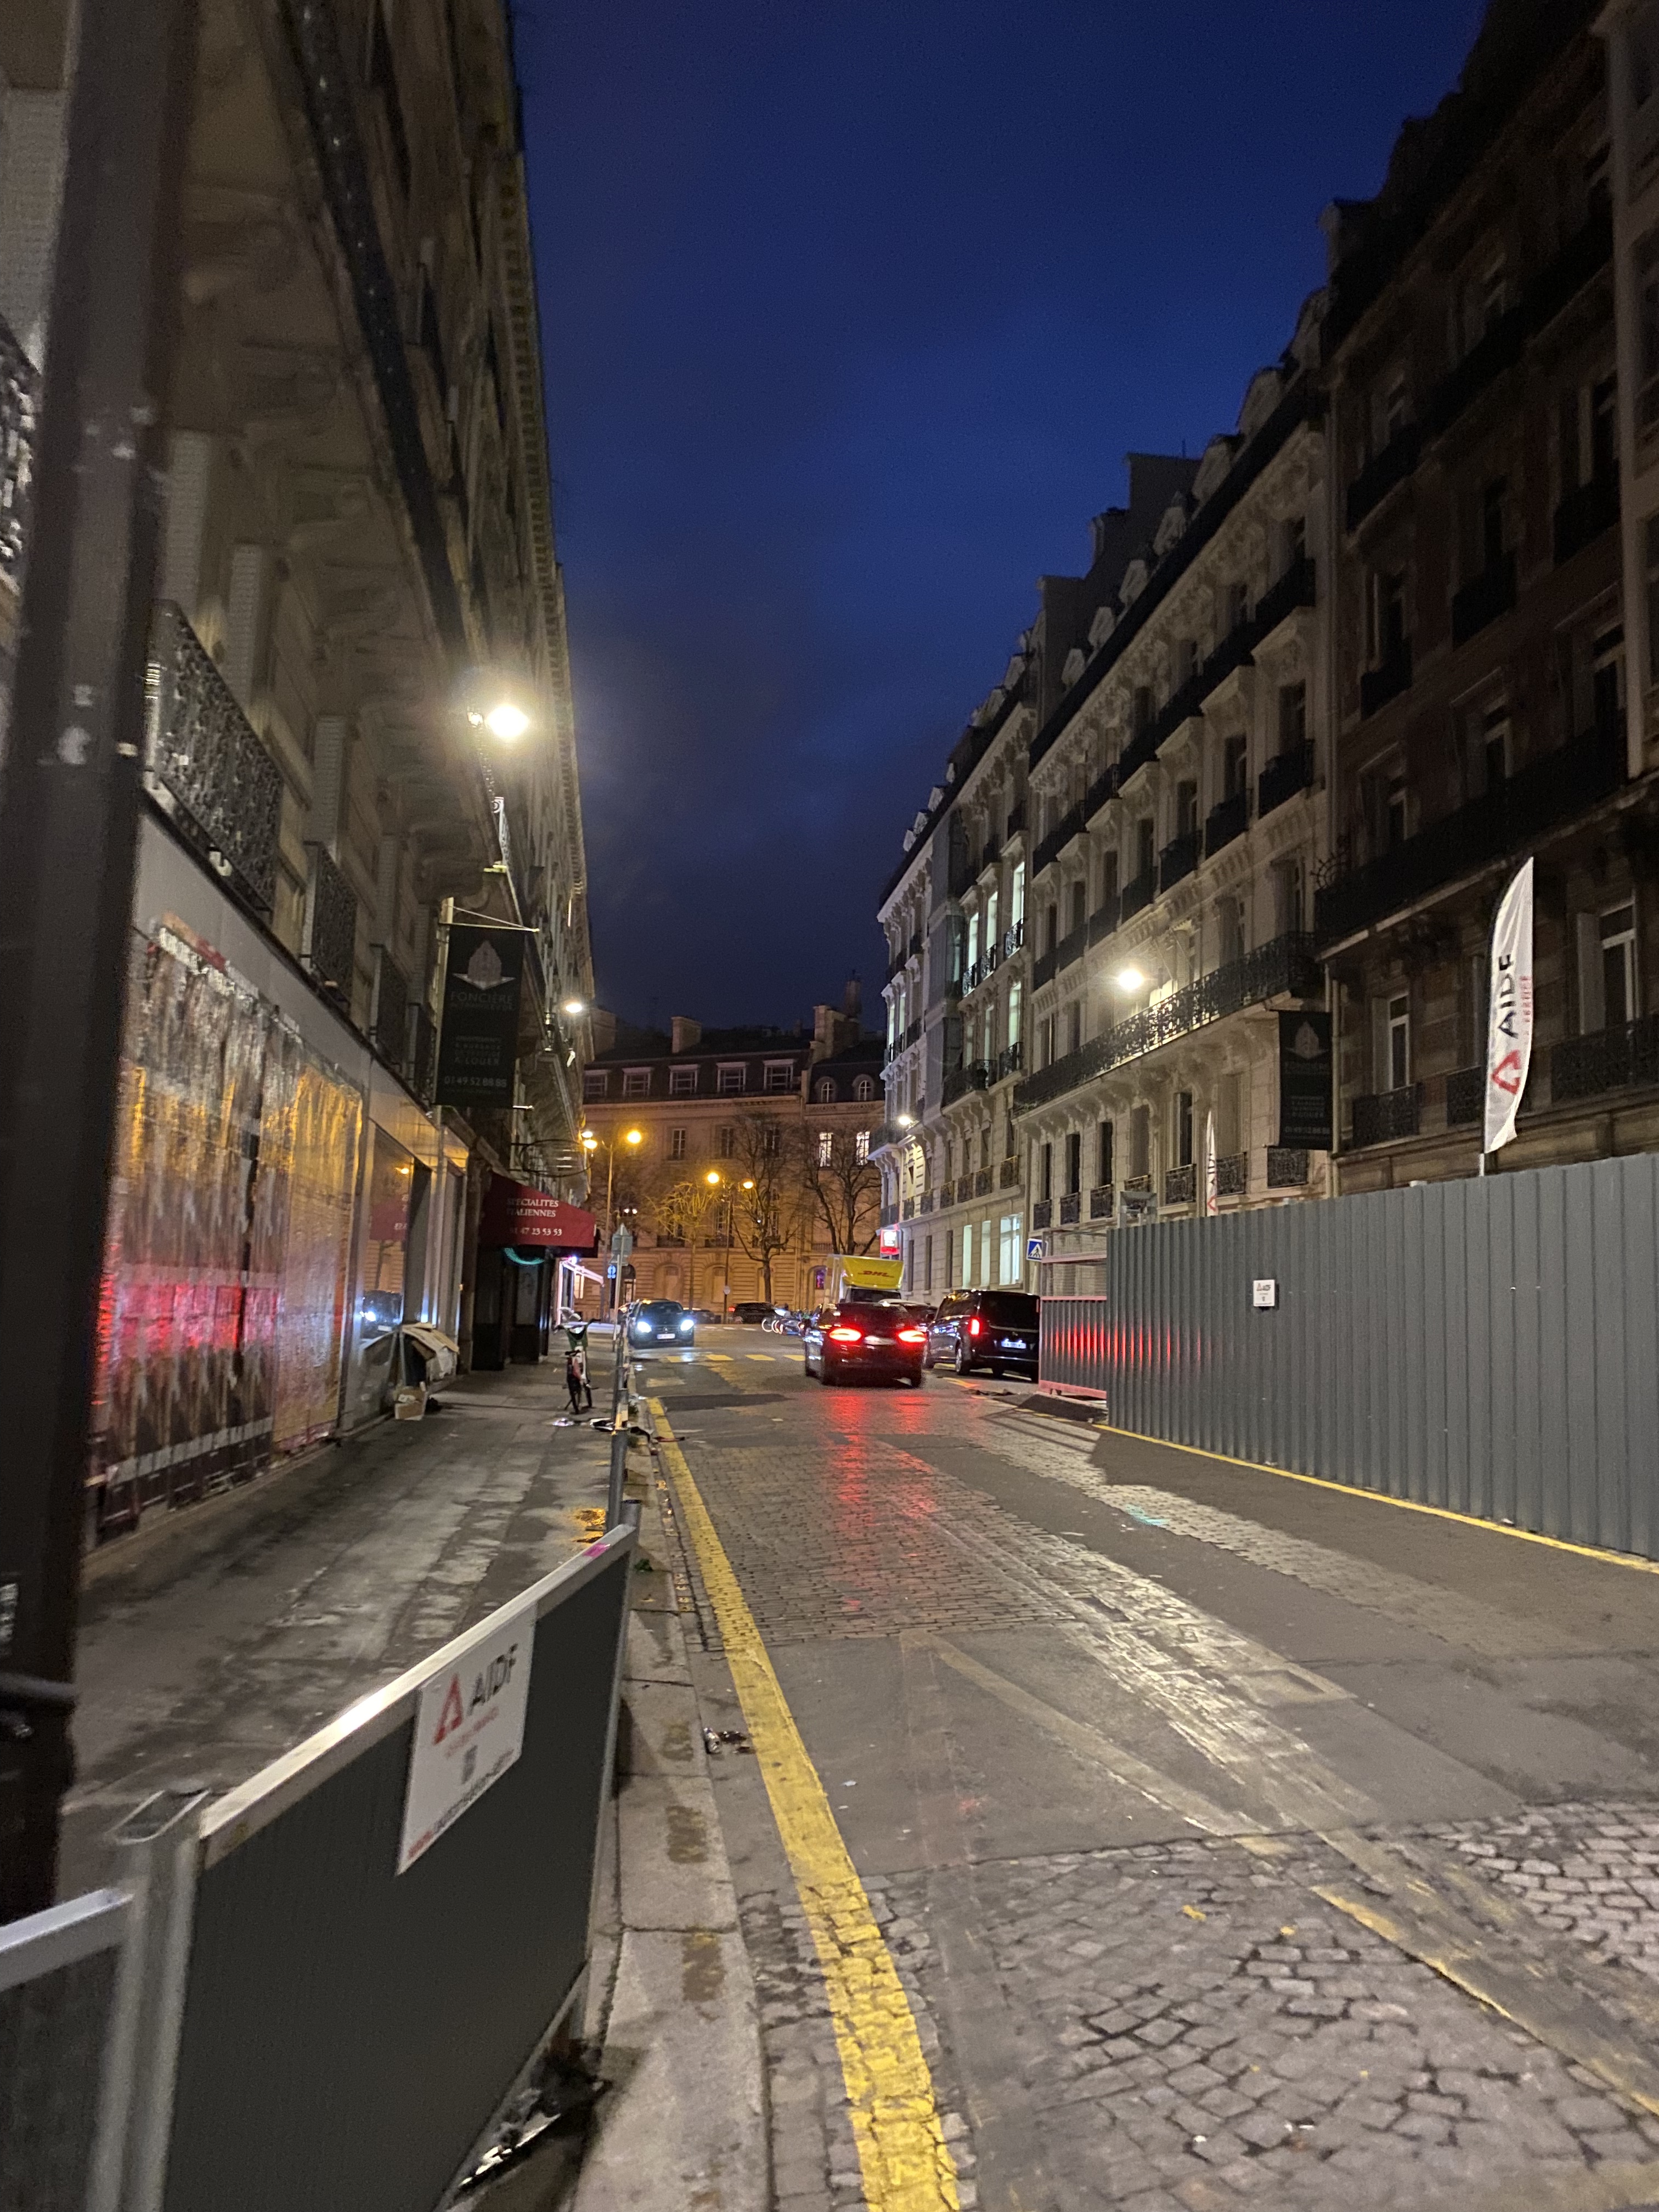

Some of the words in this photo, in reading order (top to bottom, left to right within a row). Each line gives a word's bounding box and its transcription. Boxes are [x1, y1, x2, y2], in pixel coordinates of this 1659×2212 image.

[1498, 954, 1519, 1039] AIDF
[456, 1076, 469, 1085] 49
[470, 1077, 481, 1086] 52
[506, 1208, 556, 1217] ITALIENNES
[542, 1228, 551, 1236] 53
[553, 1228, 562, 1237] 53
